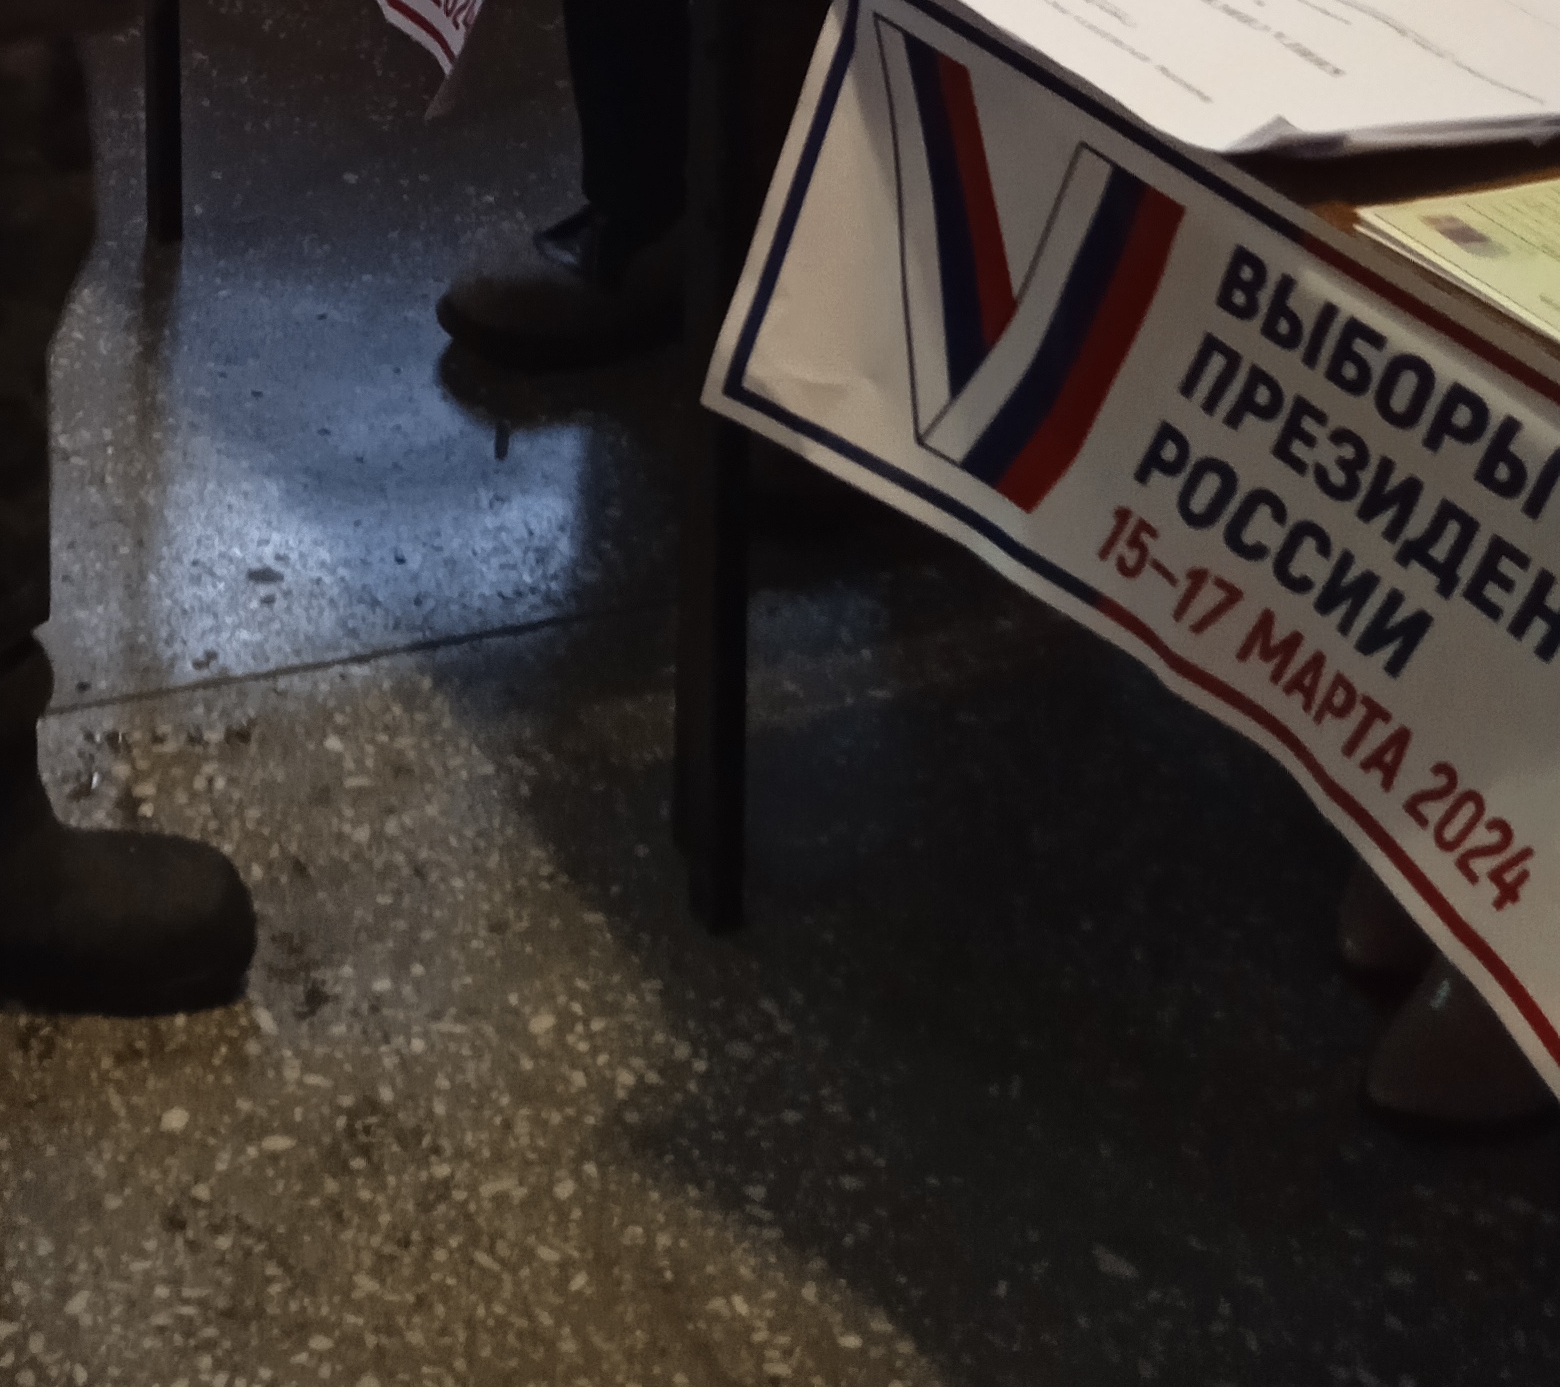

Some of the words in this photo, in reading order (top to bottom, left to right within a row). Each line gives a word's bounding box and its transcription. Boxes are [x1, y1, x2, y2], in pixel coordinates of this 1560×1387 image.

[1216, 243, 1560, 521] ВЫБОРЫ
[1133, 419, 1435, 679] РОССИИ
[1236, 607, 1413, 794] МАРТА
[1403, 760, 1535, 912] 2024
